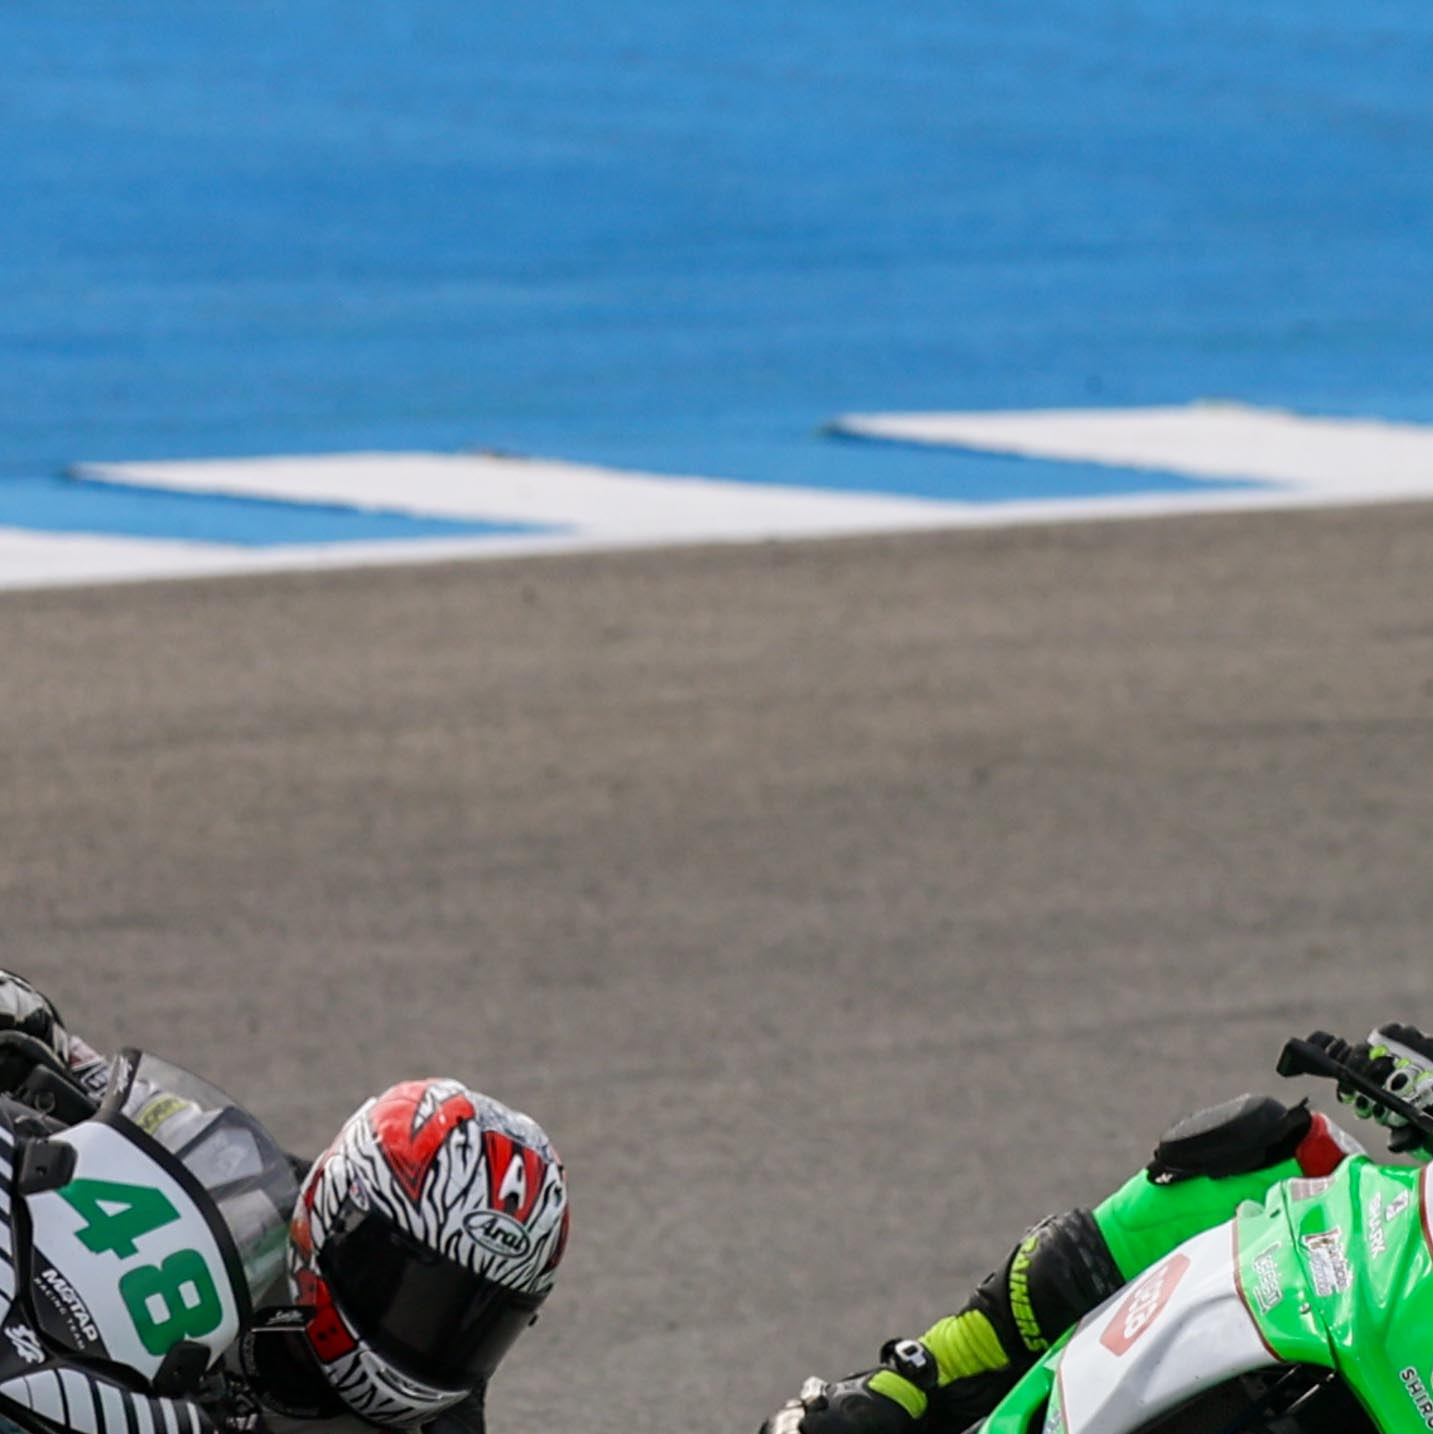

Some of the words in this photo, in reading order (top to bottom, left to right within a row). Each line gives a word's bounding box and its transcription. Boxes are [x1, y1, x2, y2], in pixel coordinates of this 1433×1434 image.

[57, 1178, 223, 1356] 48
[477, 1213, 526, 1251] Arai
[33, 1277, 67, 1316] RACING
[66, 1312, 86, 1350] TEAM
[41, 1268, 98, 1343] MOTAP
